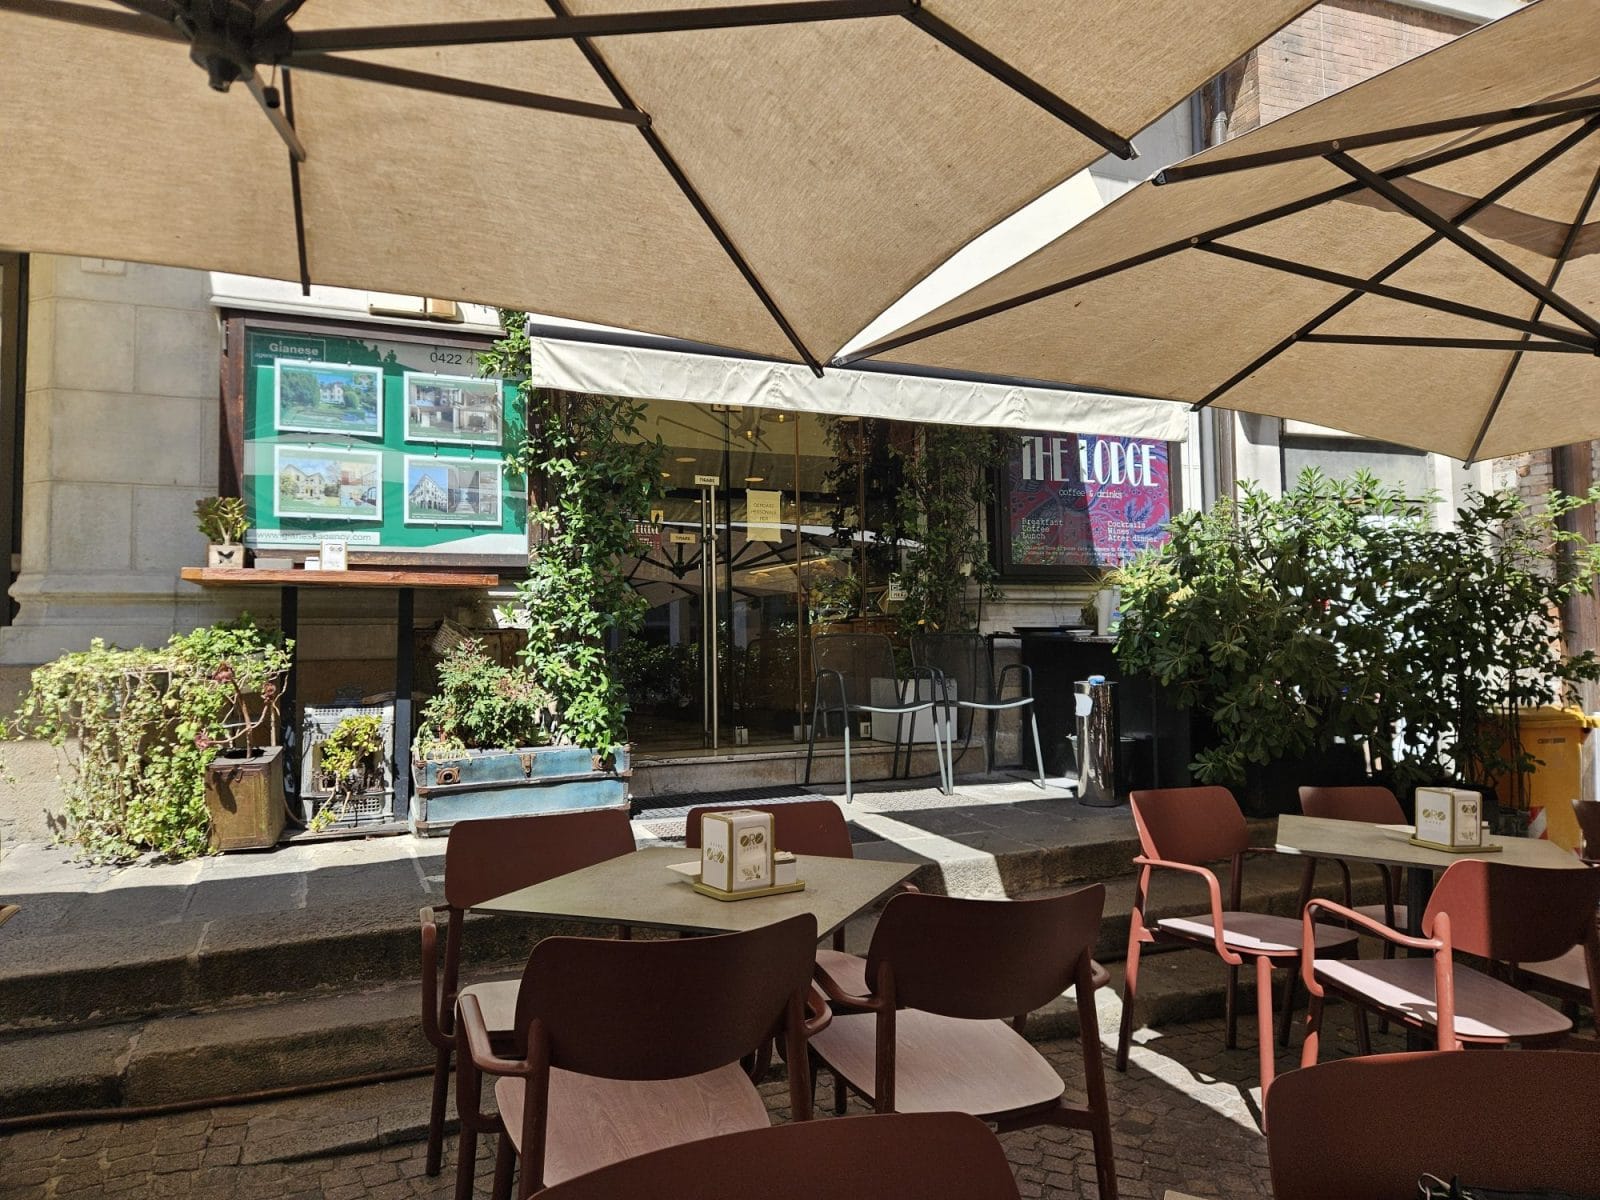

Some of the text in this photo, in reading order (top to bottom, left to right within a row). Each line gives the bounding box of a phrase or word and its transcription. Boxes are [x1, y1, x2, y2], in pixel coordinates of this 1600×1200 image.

[268, 340, 319, 356] Gianese
[430, 352, 462, 365] 0422
[1021, 435, 1159, 487] THE LODGE
[1021, 517, 1064, 527] Breakfast
[1107, 520, 1146, 529] Cocktails
[1021, 532, 1046, 540] Lunch
[740, 832, 764, 848] ORO
